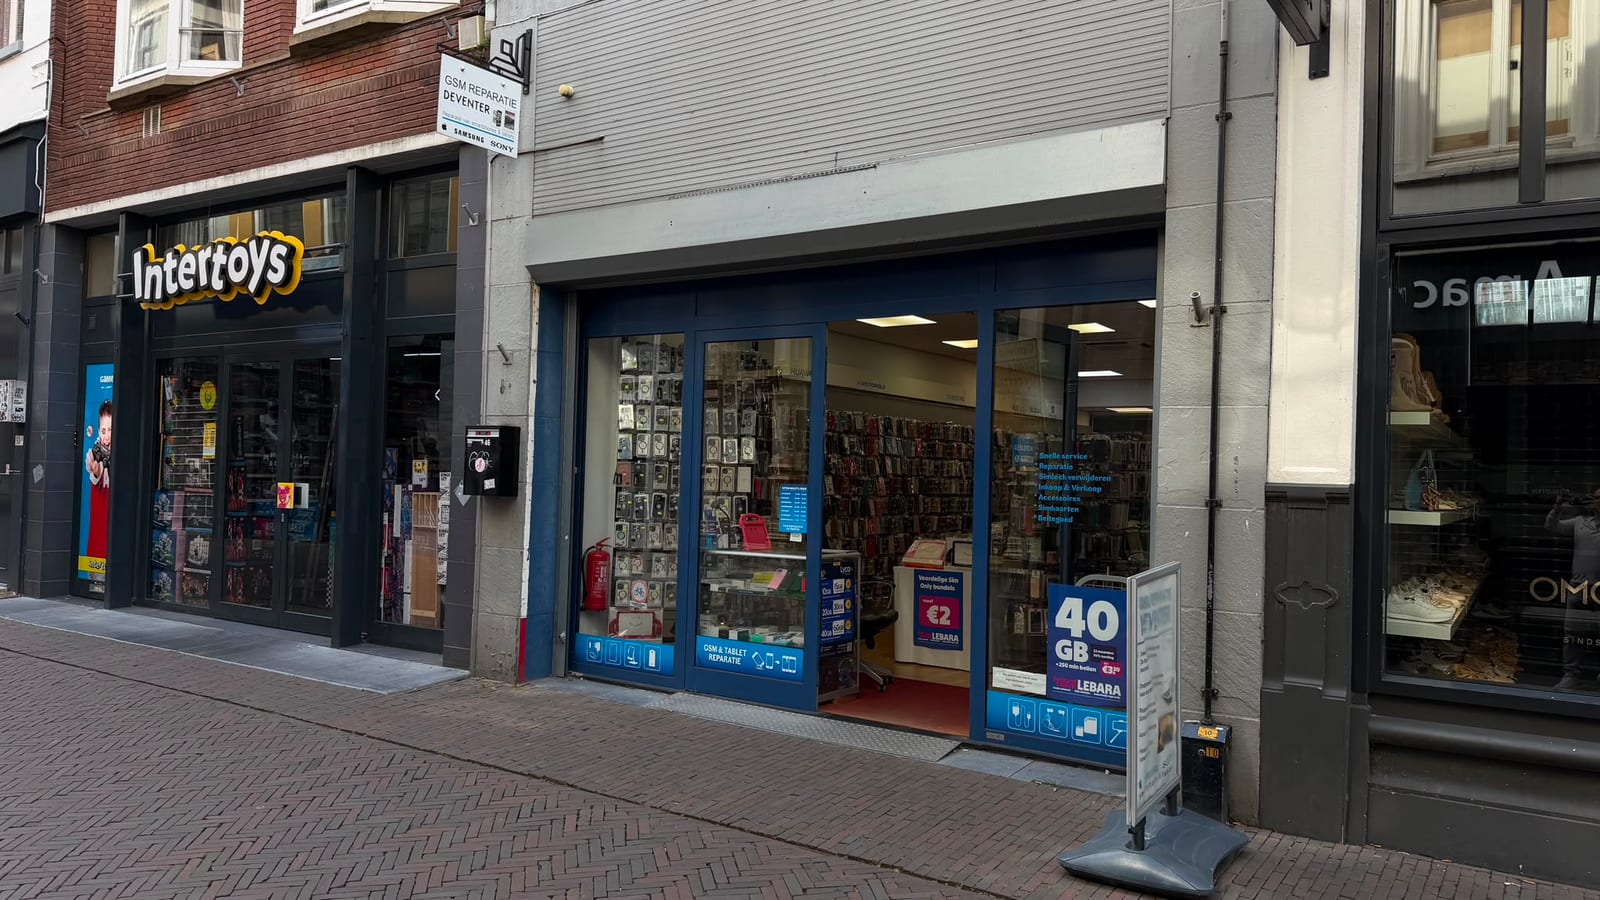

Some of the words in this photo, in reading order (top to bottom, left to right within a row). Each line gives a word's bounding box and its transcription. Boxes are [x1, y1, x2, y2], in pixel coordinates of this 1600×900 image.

[444, 75, 467, 92] GSM
[468, 83, 517, 109] REPARATIE
[443, 89, 490, 115] DEVENTER
[453, 128, 485, 144] SAMSUNG
[490, 140, 514, 153] SONY
[132, 236, 290, 301] Intertoys
[1039, 452, 1060, 460] Snelle
[1039, 462, 1073, 471] Reparatie
[1039, 473, 1067, 481] Simlock
[1067, 474, 1112, 482] verwijderen
[1038, 484, 1063, 492] Inkoop
[1071, 485, 1102, 493] Verkoop
[1038, 494, 1081, 502] Accessoires
[1038, 504, 1080, 513] Simkaarten
[1037, 514, 1073, 524] Beltegoed
[918, 574, 947, 583] Voordelige
[948, 576, 959, 584] Sim
[920, 583, 933, 591] Only
[933, 583, 956, 591] bundels
[926, 605, 951, 626] €2
[1055, 597, 1119, 642] 40
[931, 632, 959, 642] LEBARA
[703, 644, 717, 653] GSM
[718, 646, 724, 654] &
[724, 647, 748, 657] TABLET
[1055, 639, 1089, 663] GB
[708, 654, 742, 665] REPARATIE
[1079, 665, 1097, 673] bellen
[1077, 680, 1121, 697] LEBARA
